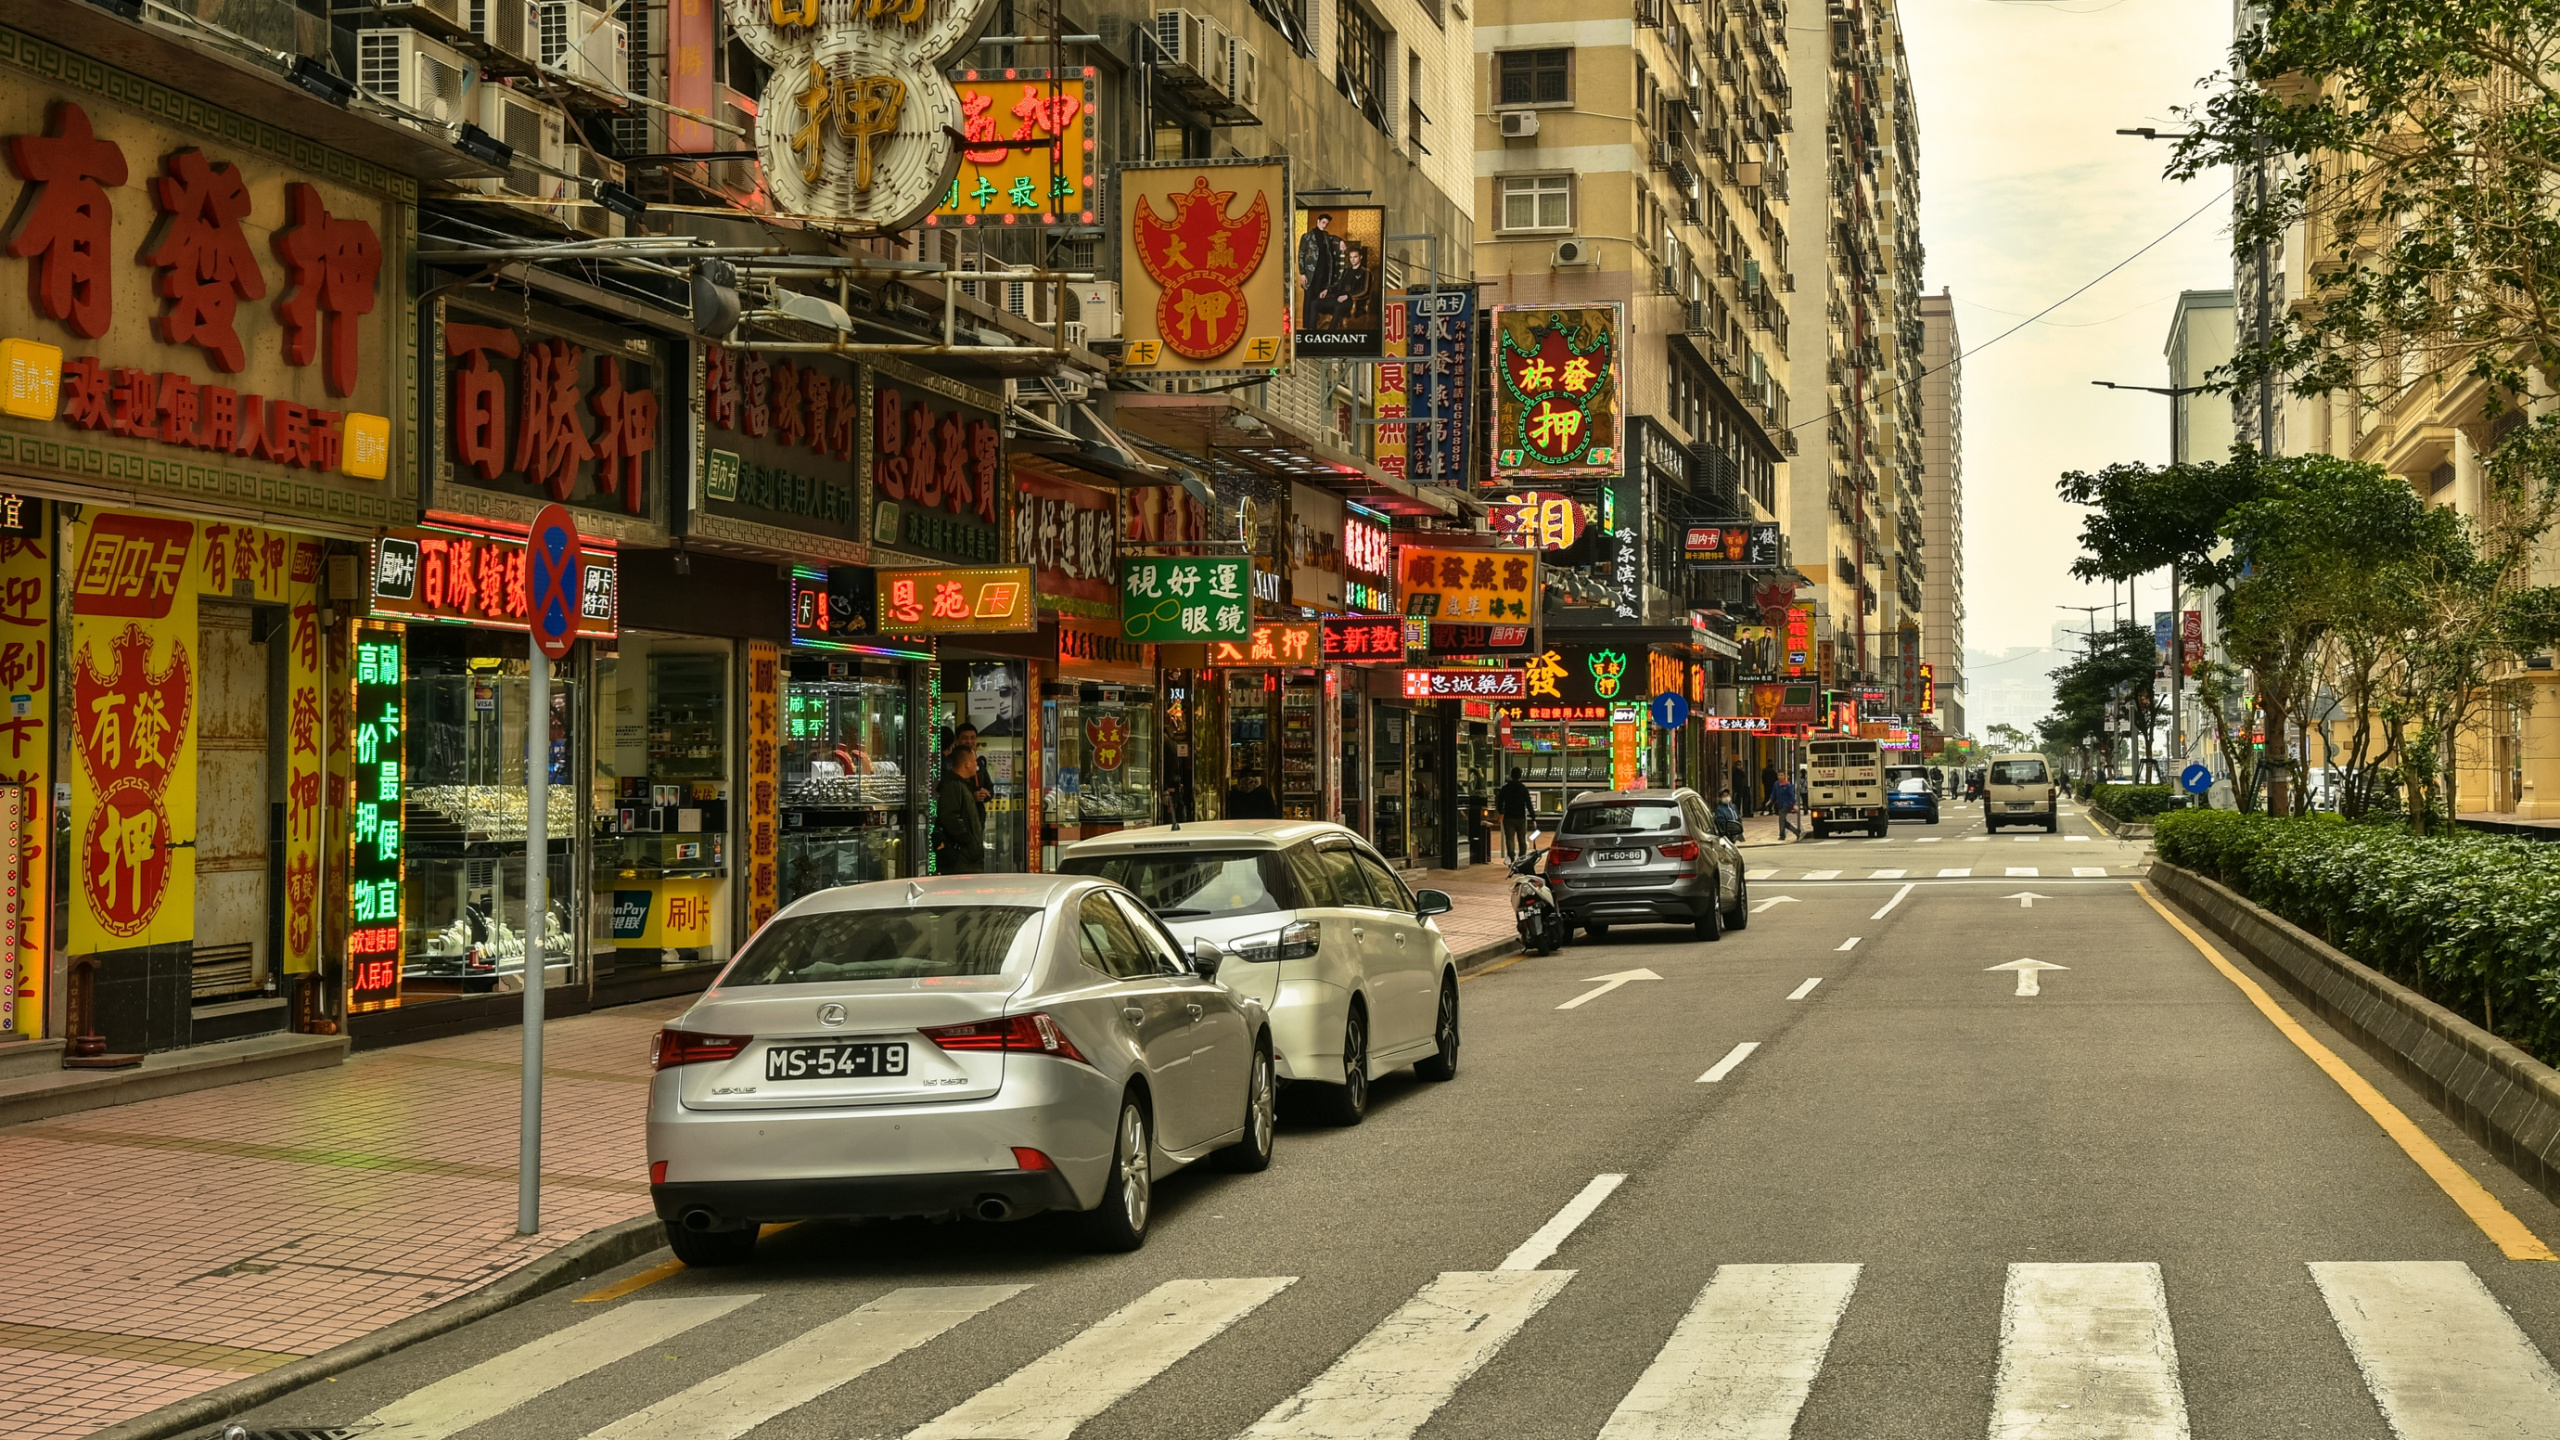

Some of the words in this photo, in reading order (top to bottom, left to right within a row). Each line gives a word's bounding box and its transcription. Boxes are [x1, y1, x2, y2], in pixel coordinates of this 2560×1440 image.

[791, 59, 907, 192] 押
[5, 101, 383, 399] 有發押
[1173, 287, 1232, 346] 押
[1134, 341, 1154, 363] 卡
[1251, 338, 1272, 360] 卡
[1304, 333, 1368, 345] GAGNANT
[63, 355, 343, 473] 欢迎使用人民币
[444, 322, 659, 514] 百勝押
[1501, 401, 1515, 447] 有限公司
[1529, 401, 1583, 455] 押
[873, 387, 999, 526] 恩施珠寶
[1504, 491, 1575, 550] 湘
[1687, 533, 1719, 546] 国内卡
[76, 532, 186, 600] 国内卡
[202, 521, 286, 598] 有發押
[1407, 555, 1529, 592] 順發燕窩
[984, 586, 1011, 613] 卡
[1126, 564, 1243, 599] 視好運
[888, 579, 971, 623] 恩施
[1181, 604, 1247, 635] 眼鏡
[1493, 627, 1526, 641] 国内卡
[1430, 673, 1522, 695] 忠誠藥房
[1599, 677, 1616, 696] 押
[289, 600, 322, 843] 有發押
[476, 700, 493, 708] VISA
[789, 696, 825, 713] 刷卡
[88, 689, 172, 770] 有發
[98, 803, 158, 915] 押
[1598, 851, 1641, 861] MT-60-86
[666, 894, 710, 932] 刷卡
[353, 927, 397, 954] 欢迎使用
[354, 960, 394, 990] 人民币
[768, 1045, 905, 1078] MS-54-19
[711, 1086, 757, 1096] LEXUS
